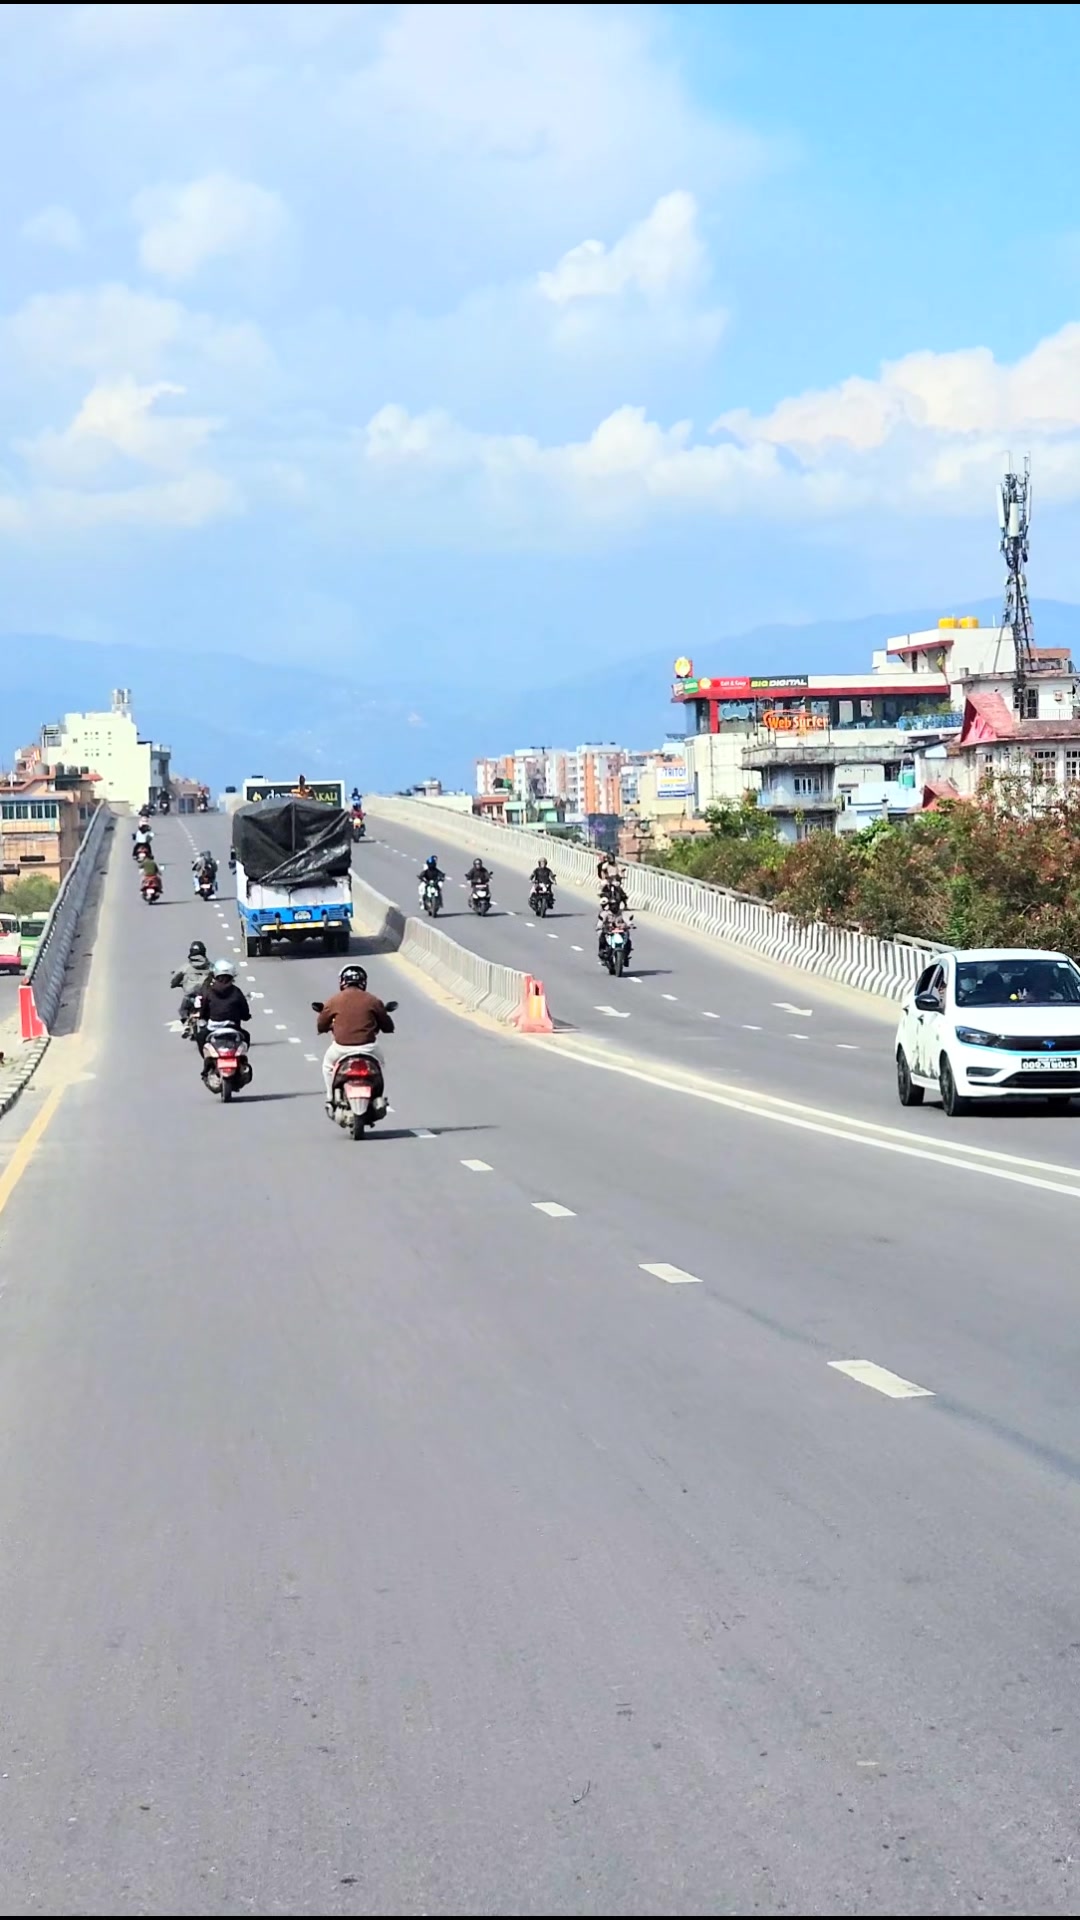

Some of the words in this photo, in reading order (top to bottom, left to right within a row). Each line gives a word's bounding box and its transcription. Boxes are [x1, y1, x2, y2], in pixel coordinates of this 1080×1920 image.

[751, 680, 769, 688] BIG
[769, 679, 807, 687] DIGITAL
[767, 716, 792, 728] Web
[792, 715, 829, 728] Surfer
